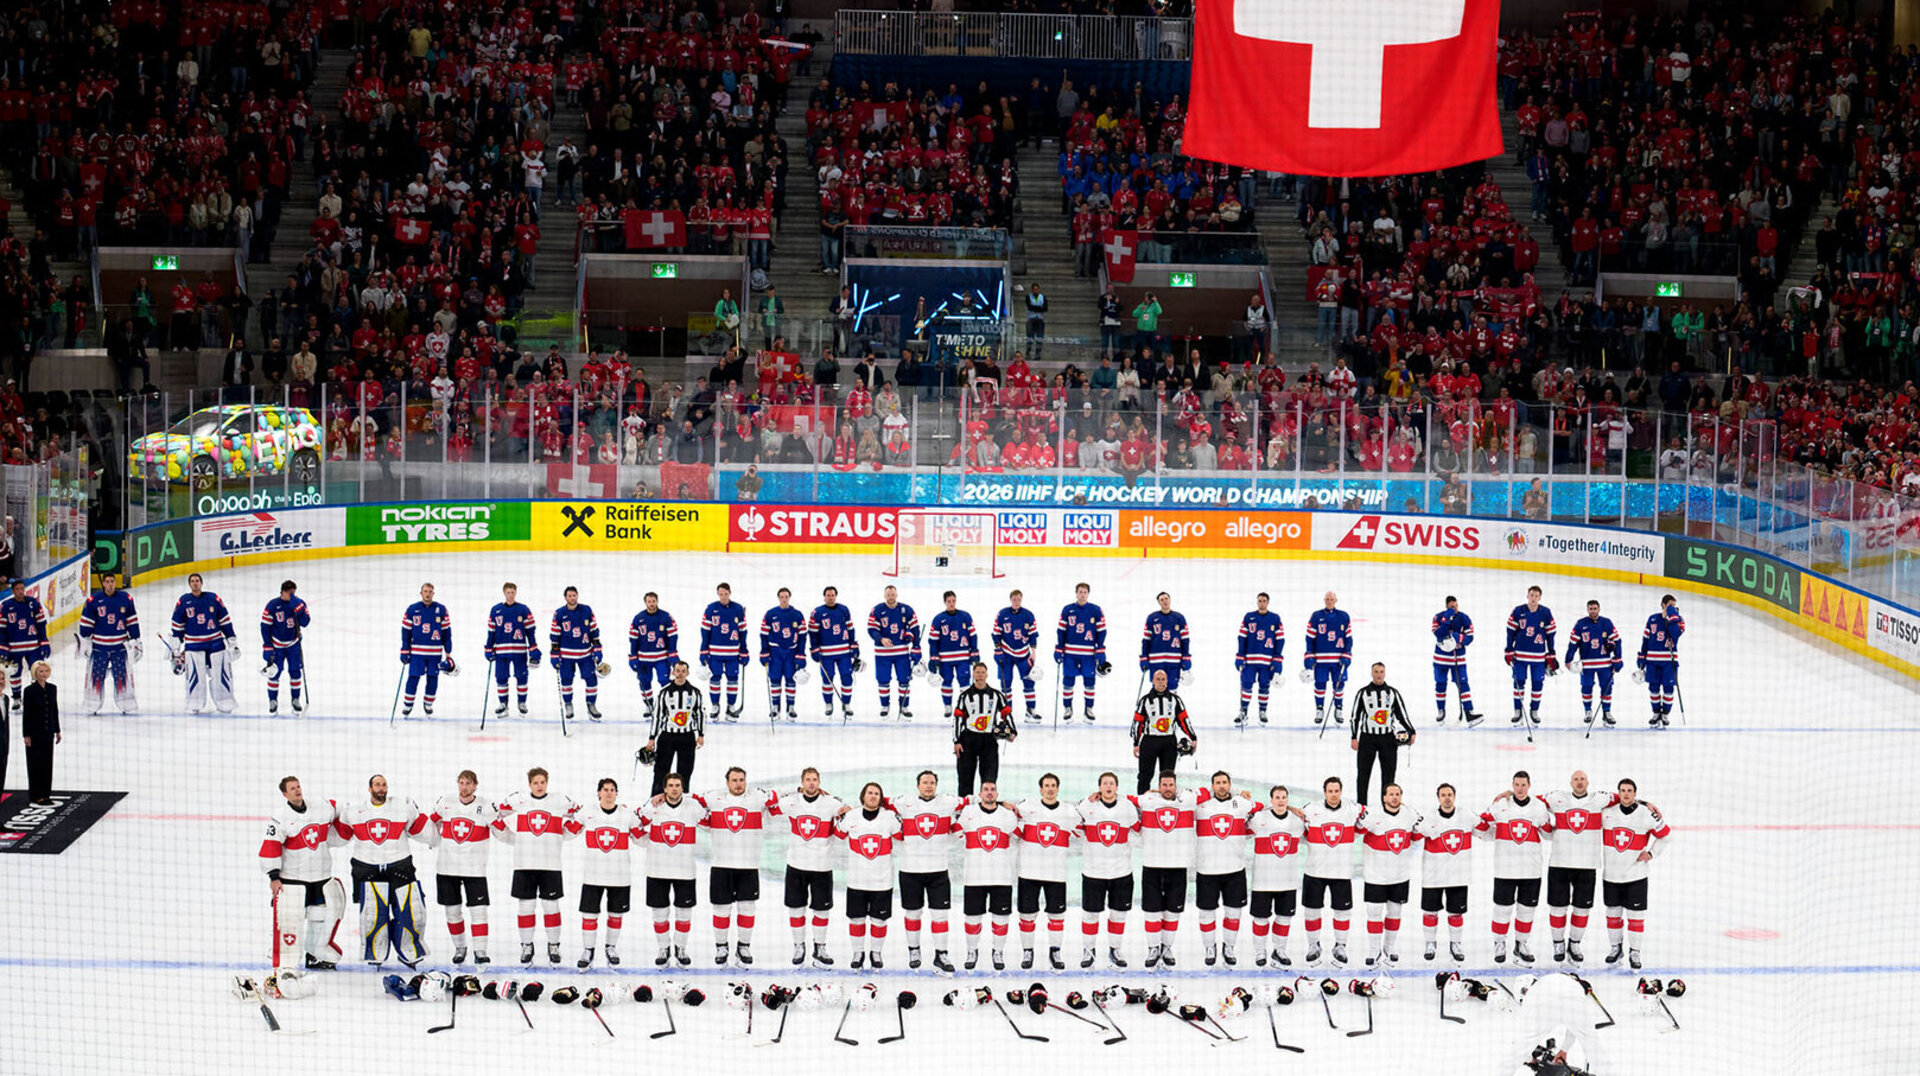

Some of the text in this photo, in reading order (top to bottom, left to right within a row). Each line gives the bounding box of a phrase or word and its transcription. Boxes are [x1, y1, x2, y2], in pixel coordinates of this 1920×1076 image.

[968, 334, 986, 346] TO
[954, 345, 991, 357] SHNE
[963, 484, 1013, 501] 2026
[1015, 485, 1053, 501] IIHF
[1089, 485, 1170, 503] HOCKEY
[1171, 486, 1241, 504] WORLD
[1243, 487, 1389, 505] CHAMPIONSHIP
[605, 505, 699, 522] Raiffeisen
[1000, 514, 1045, 529] LIQUI
[1066, 515, 1110, 529] LIQUI
[381, 523, 489, 542] TYRES
[605, 524, 652, 540] Bank
[769, 511, 916, 538] STRAUSS
[1129, 515, 1206, 543] allegro
[1225, 516, 1301, 544] allegro
[999, 529, 1045, 543] MOLY
[1065, 530, 1111, 544] MOLY
[1384, 521, 1480, 551] SWISS
[1538, 535, 1655, 563] #Together4Integrity
[1890, 616, 1920, 647] TISSO
